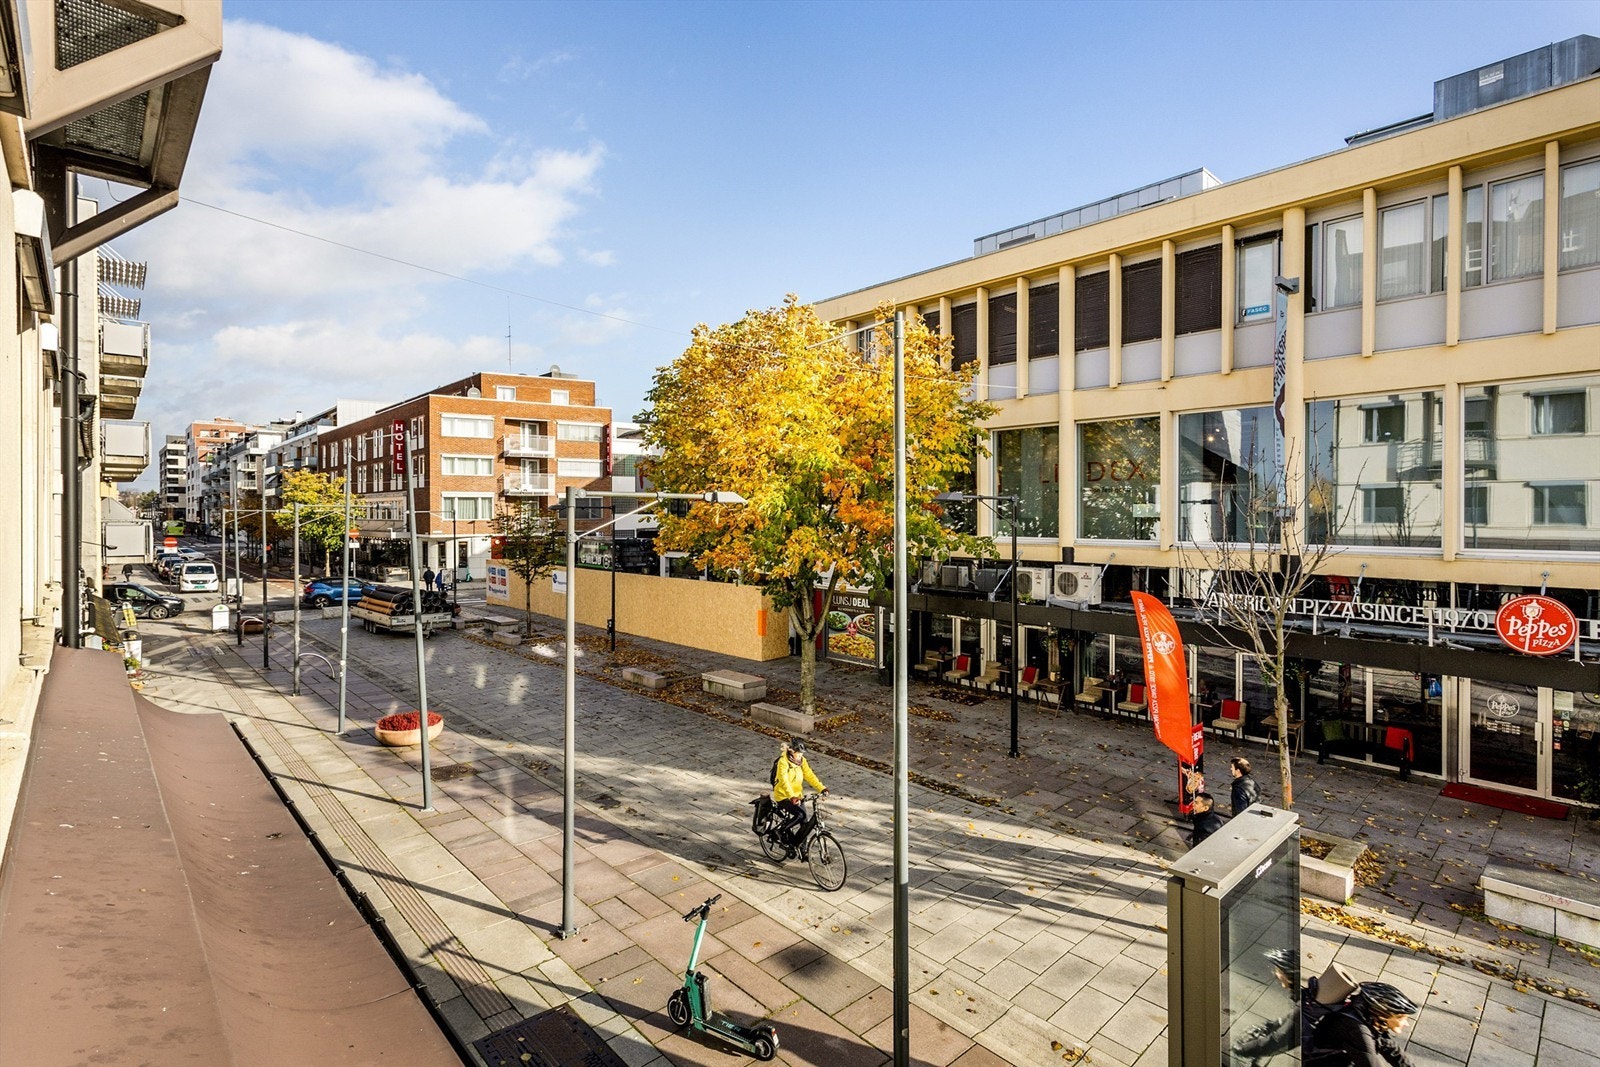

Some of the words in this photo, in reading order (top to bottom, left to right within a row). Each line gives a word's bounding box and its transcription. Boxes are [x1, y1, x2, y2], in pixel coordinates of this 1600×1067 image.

[1247, 306, 1267, 314] FASEC
[395, 424, 403, 470] HOTEL
[1039, 459, 1146, 484] LIDEX
[853, 598, 870, 608] DEAL
[1208, 592, 1296, 614] AMERICAN
[1303, 598, 1356, 619] PIZZA
[1361, 603, 1426, 624] SINCE
[1434, 609, 1489, 630] 1970
[721, 1020, 742, 1032] TIER
